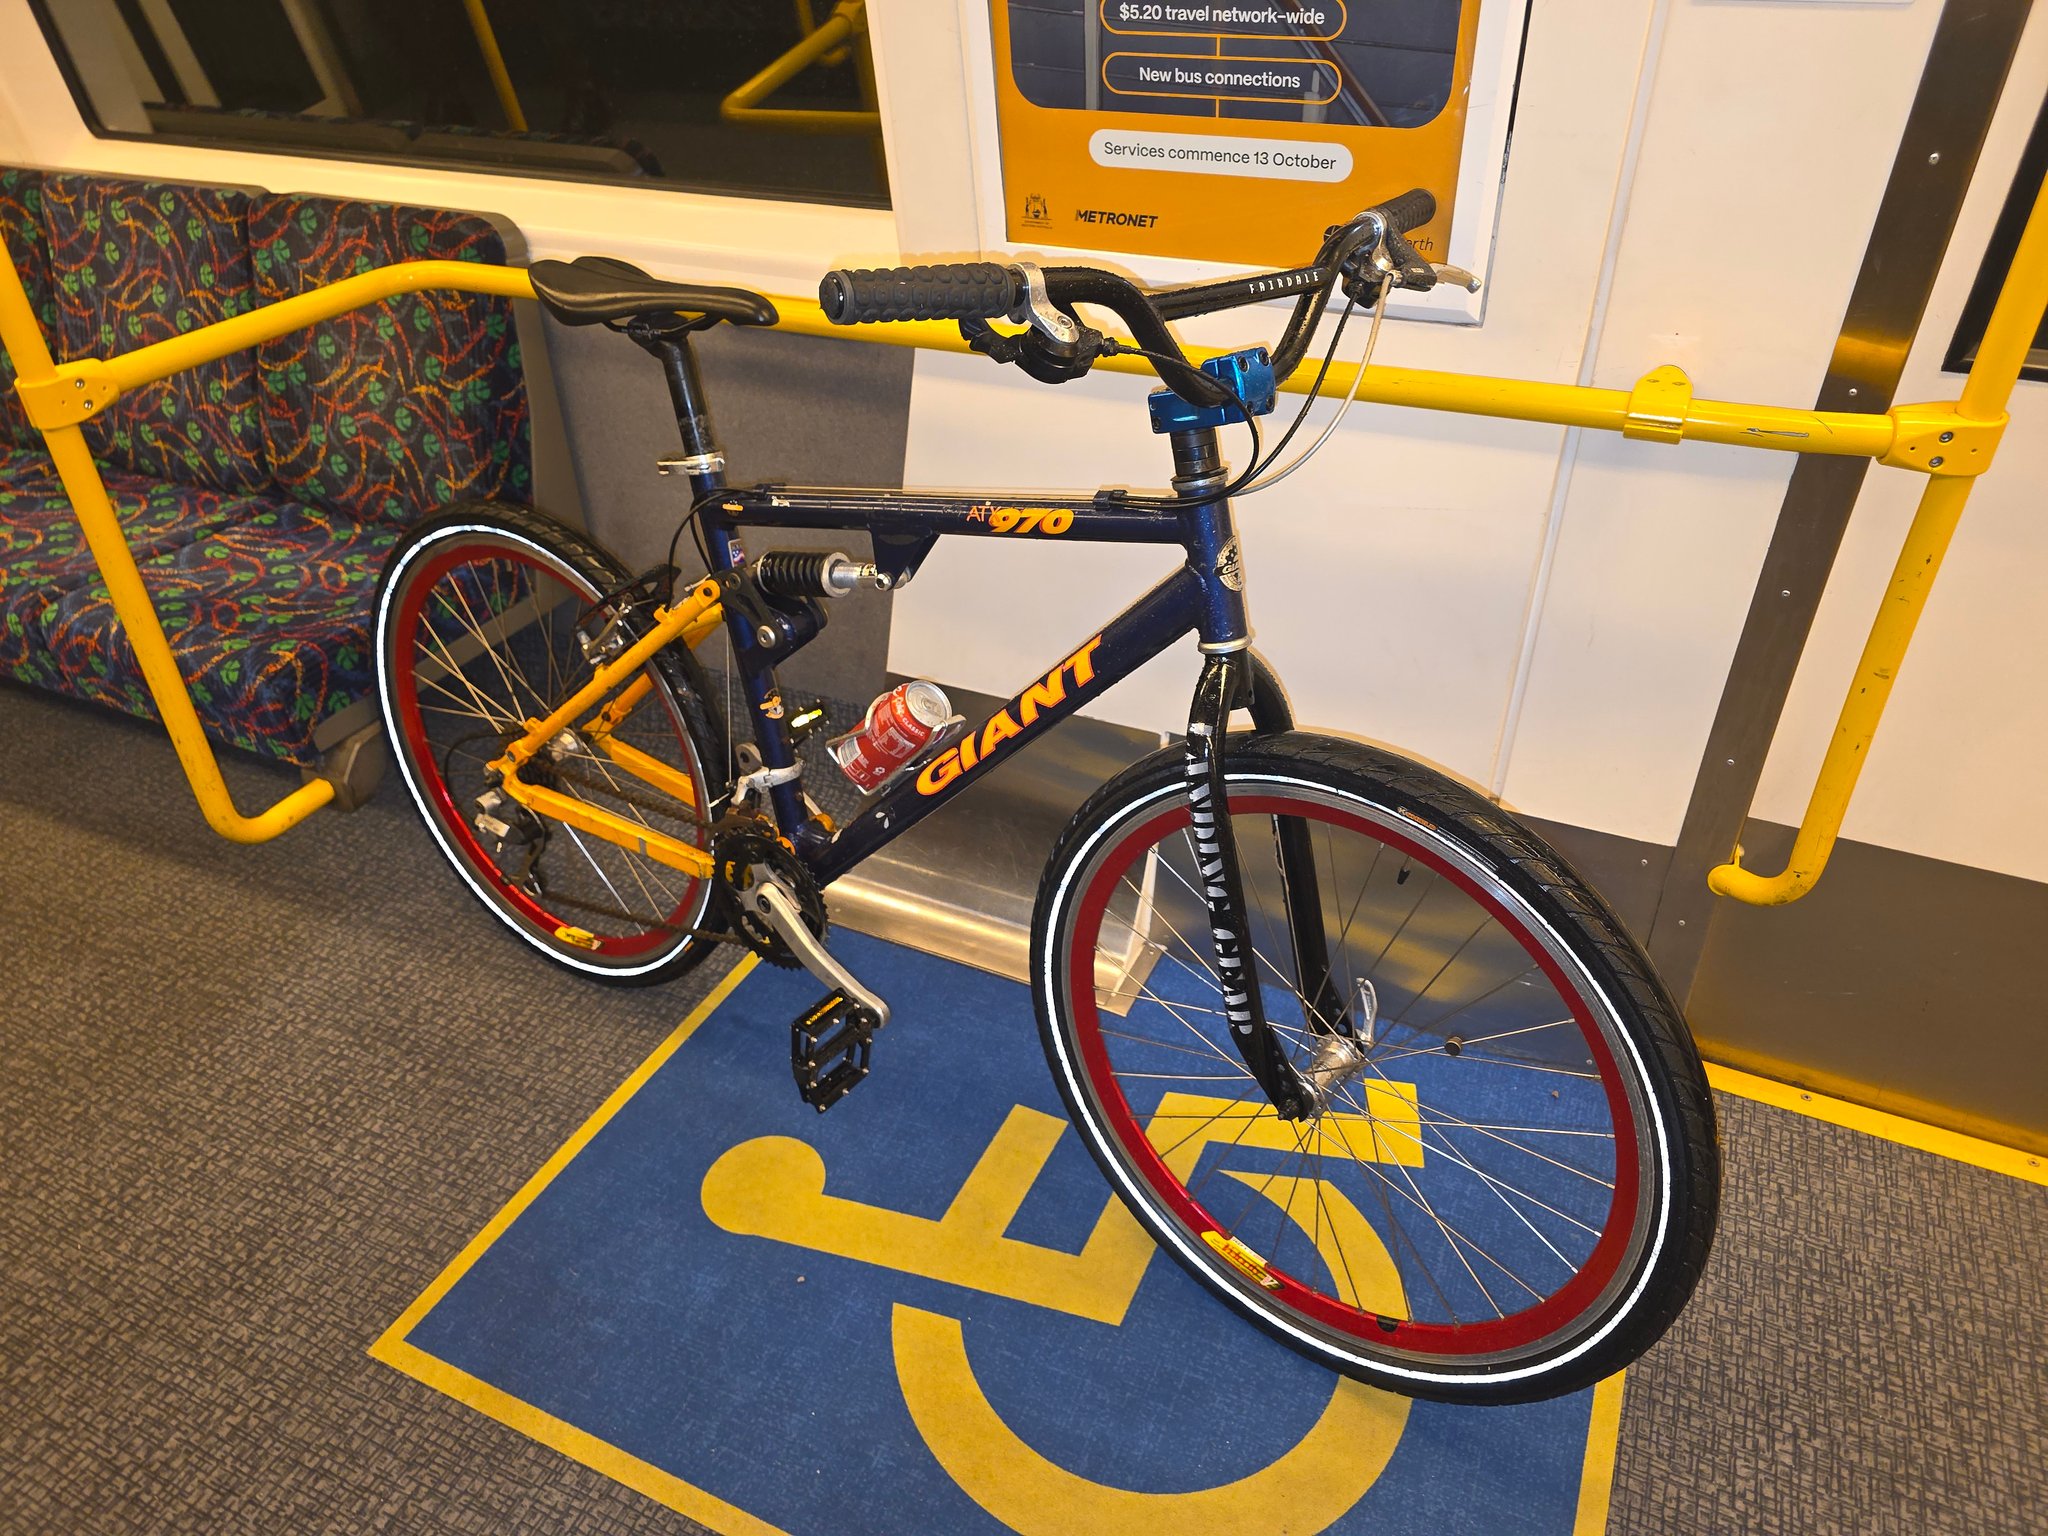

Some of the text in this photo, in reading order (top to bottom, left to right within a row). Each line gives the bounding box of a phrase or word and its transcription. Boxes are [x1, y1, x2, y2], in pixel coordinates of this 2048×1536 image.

[1119, 2, 1325, 25] $5.20 travel network-wide
[1139, 67, 1301, 88] New bus connections
[1104, 141, 1337, 170] Services commence 13 October
[1075, 209, 1159, 228] METRONET
[1249, 271, 1319, 294] FAIRDALE
[989, 507, 1075, 535] 970
[916, 634, 1102, 796] GIANT
[902, 717, 926, 737] CLASSIC
